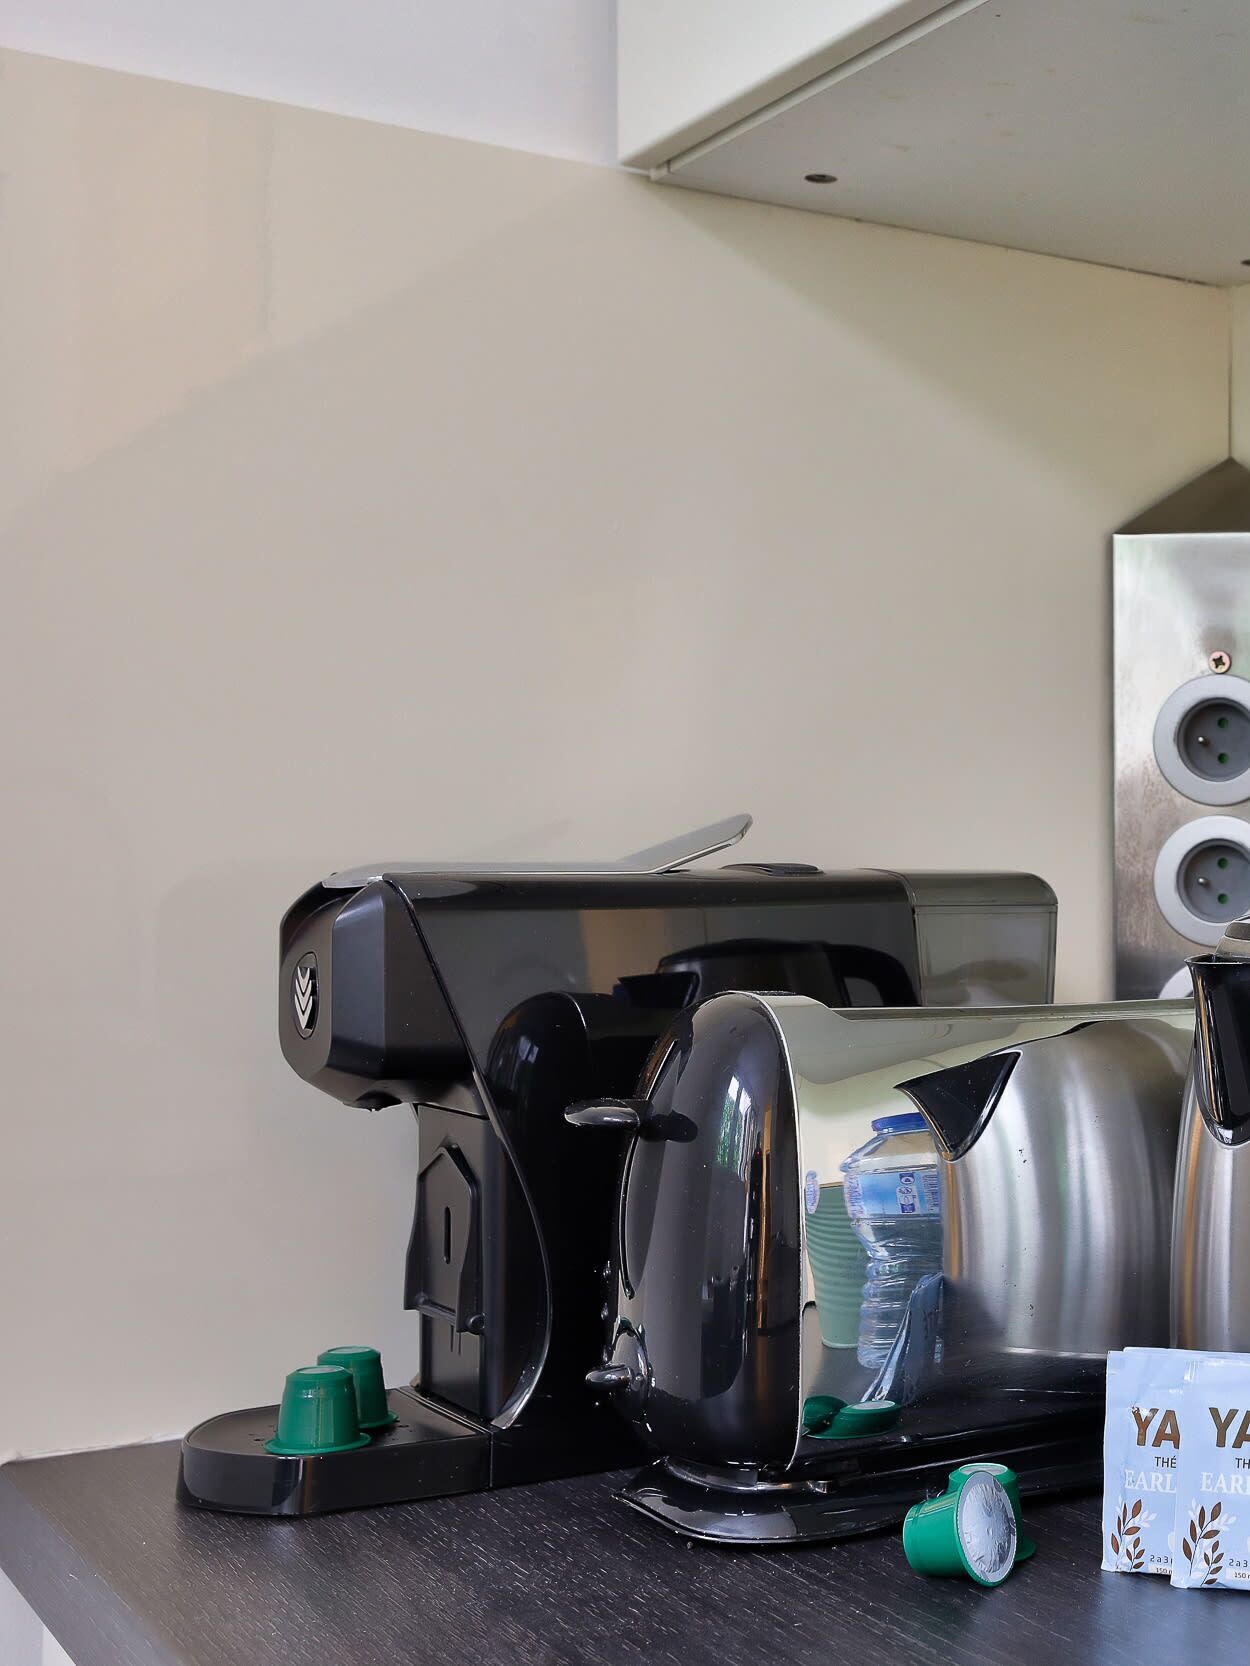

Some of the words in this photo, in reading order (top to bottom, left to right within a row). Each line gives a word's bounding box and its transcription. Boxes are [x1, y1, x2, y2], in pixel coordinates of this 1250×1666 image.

[1131, 1406, 1181, 1450] YA
[1154, 1456, 1177, 1469] THÉ
[1124, 1469, 1177, 1494] EARL
[1150, 1555, 1155, 1563] 2
[1164, 1555, 1169, 1564] 3
[1228, 1558, 1234, 1567] 2
[1243, 1560, 1248, 1568] 3
[1234, 1571, 1247, 1579] 150
